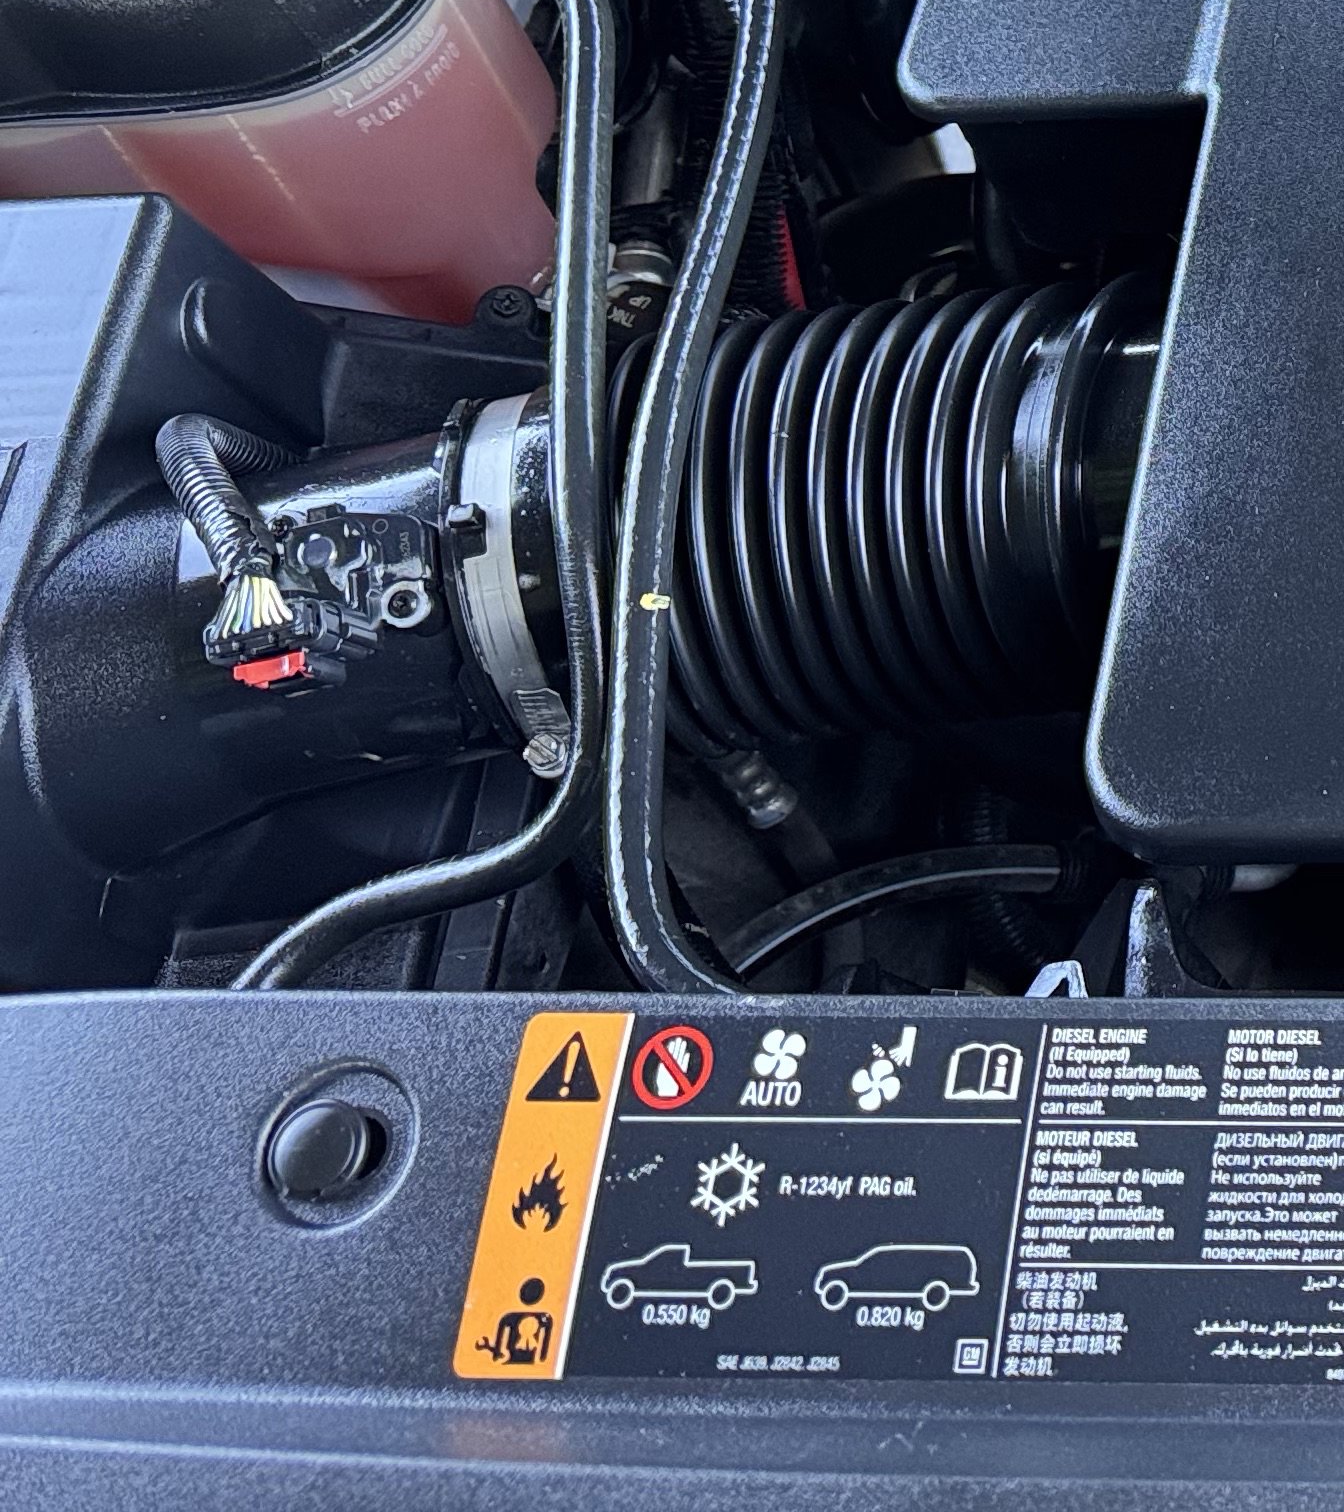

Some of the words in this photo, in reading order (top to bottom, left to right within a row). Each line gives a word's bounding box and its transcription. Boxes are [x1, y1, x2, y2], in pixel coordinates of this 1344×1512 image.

[1052, 1028, 1096, 1043] DIESEL
[1099, 1028, 1148, 1044] ENGINE
[1228, 1029, 1274, 1044] MOTOR
[1277, 1030, 1321, 1045] DIESEL
[1050, 1047, 1062, 1063] (If
[1066, 1046, 1130, 1064] Equipped)
[1226, 1047, 1243, 1064] (Si
[1246, 1048, 1258, 1062] lo
[1262, 1048, 1298, 1064] tiene)
[1046, 1064, 1063, 1079] Do
[1066, 1064, 1086, 1079] not
[1089, 1066, 1112, 1079] use
[1114, 1065, 1162, 1082] starting
[1165, 1065, 1202, 1080] fluids.
[1223, 1065, 1241, 1079] No
[1244, 1067, 1266, 1079] use
[1269, 1066, 1310, 1080] fluidos
[1313, 1066, 1329, 1080] de
[740, 1081, 802, 1107] AUTO
[1043, 1082, 1109, 1097] Immediate
[1112, 1082, 1153, 1100] engine
[1156, 1083, 1207, 1101] damage
[1221, 1083, 1238, 1098] Se
[1240, 1084, 1286, 1100] pueden
[1289, 1084, 1342, 1101] producir
[1041, 1101, 1063, 1114] can
[1066, 1100, 1105, 1115] result.
[1219, 1101, 1287, 1116] inmediatos
[1290, 1104, 1306, 1116] en
[1309, 1102, 1321, 1116] el
[1035, 1131, 1091, 1146] MOTEUR
[1093, 1131, 1138, 1147] DIESEL
[1214, 1131, 1304, 1150] ДИЗЕЛЬНЫЙ
[1033, 1149, 1050, 1166] (si
[1053, 1149, 1101, 1168] équipé)
[1212, 1151, 1250, 1168] (если
[1031, 1168, 1048, 1183] Ne
[1051, 1171, 1074, 1185] pas
[1077, 1169, 1120, 1183] utiliser
[1123, 1169, 1139, 1183] de
[1142, 1169, 1184, 1187] liquide
[1211, 1170, 1230, 1185] Не
[1233, 1171, 1322, 1188] используйте
[779, 1175, 854, 1200] R-1234yf
[858, 1176, 891, 1197] PAG
[893, 1176, 917, 1197] oil.
[1117, 1187, 1142, 1202] Des
[1208, 1192, 1276, 1205] жидкости
[1278, 1192, 1305, 1206] для
[1025, 1206, 1095, 1224] dommages
[1098, 1206, 1164, 1221] immédiats
[1292, 1211, 1338, 1223] может
[1022, 1227, 1039, 1239] au
[1042, 1225, 1088, 1239] moteur
[1089, 1225, 1155, 1243] pourraient
[1158, 1228, 1174, 1240] en
[1204, 1229, 1261, 1241] вызвать
[1020, 1242, 1071, 1258] résulter.
[1201, 1248, 1300, 1262] повреждение
[1015, 1271, 1097, 1291] 柴油发动机
[642, 1304, 687, 1325] 0.550
[690, 1304, 711, 1329] kg
[856, 1306, 901, 1327] 0.820
[904, 1307, 925, 1331] kg
[1006, 1334, 1122, 1355] 否则会立即损坏
[963, 1346, 981, 1365] GM
